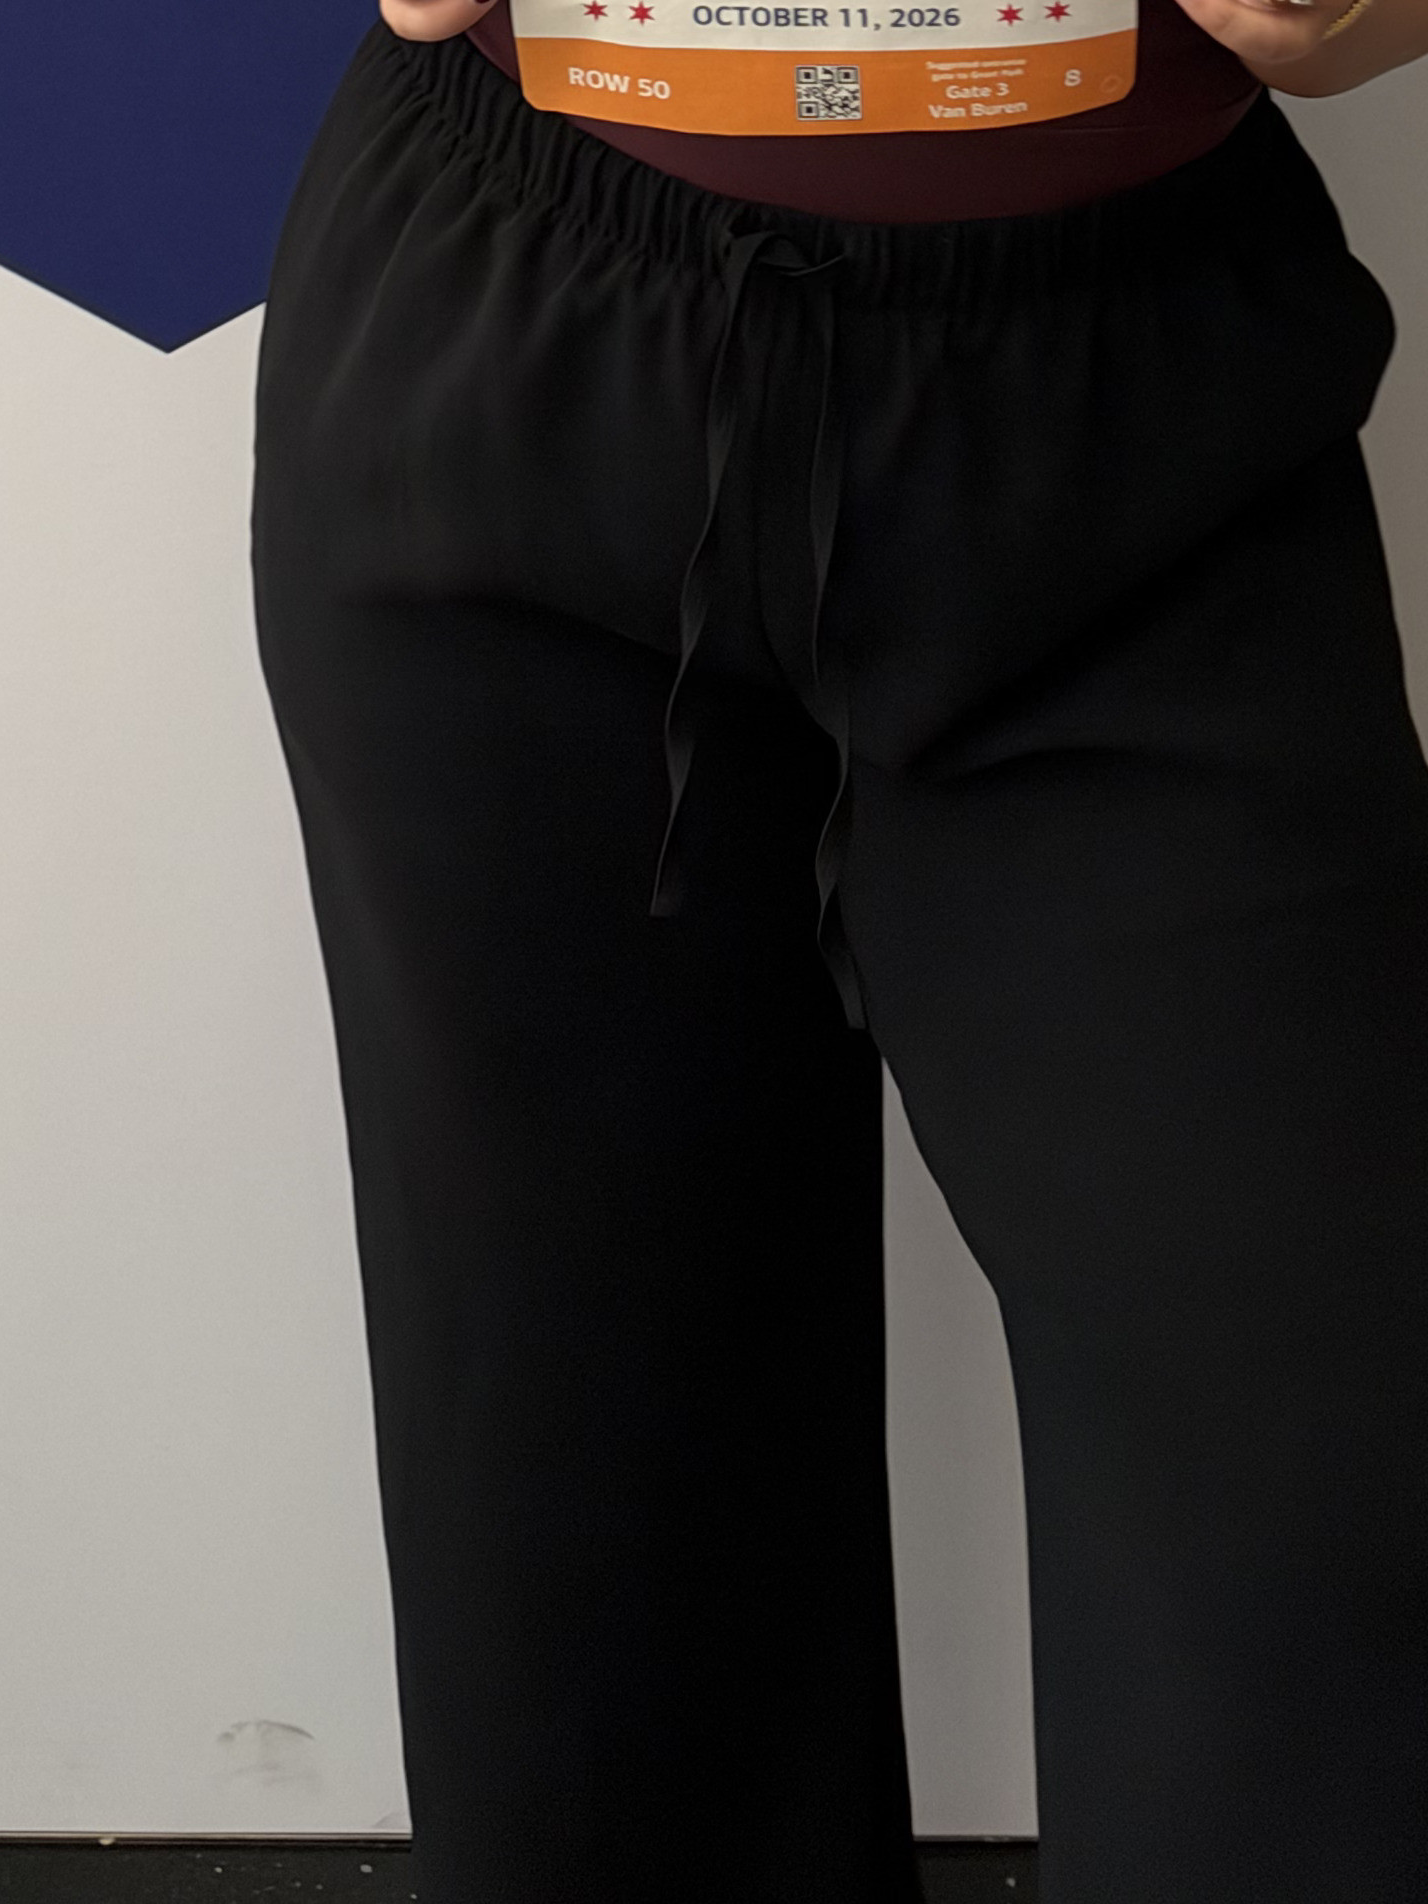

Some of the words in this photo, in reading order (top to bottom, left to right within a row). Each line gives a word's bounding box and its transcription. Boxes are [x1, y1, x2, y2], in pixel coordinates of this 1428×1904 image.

[692, 5, 829, 28] OCTOBER
[838, 8, 882, 31] 11,
[889, 7, 961, 28] 2026
[567, 66, 631, 95] ROW
[637, 78, 671, 101] 50
[945, 84, 992, 100] Gate
[996, 82, 1010, 97] 3
[928, 104, 966, 119] Van
[971, 102, 1028, 117] Buren
